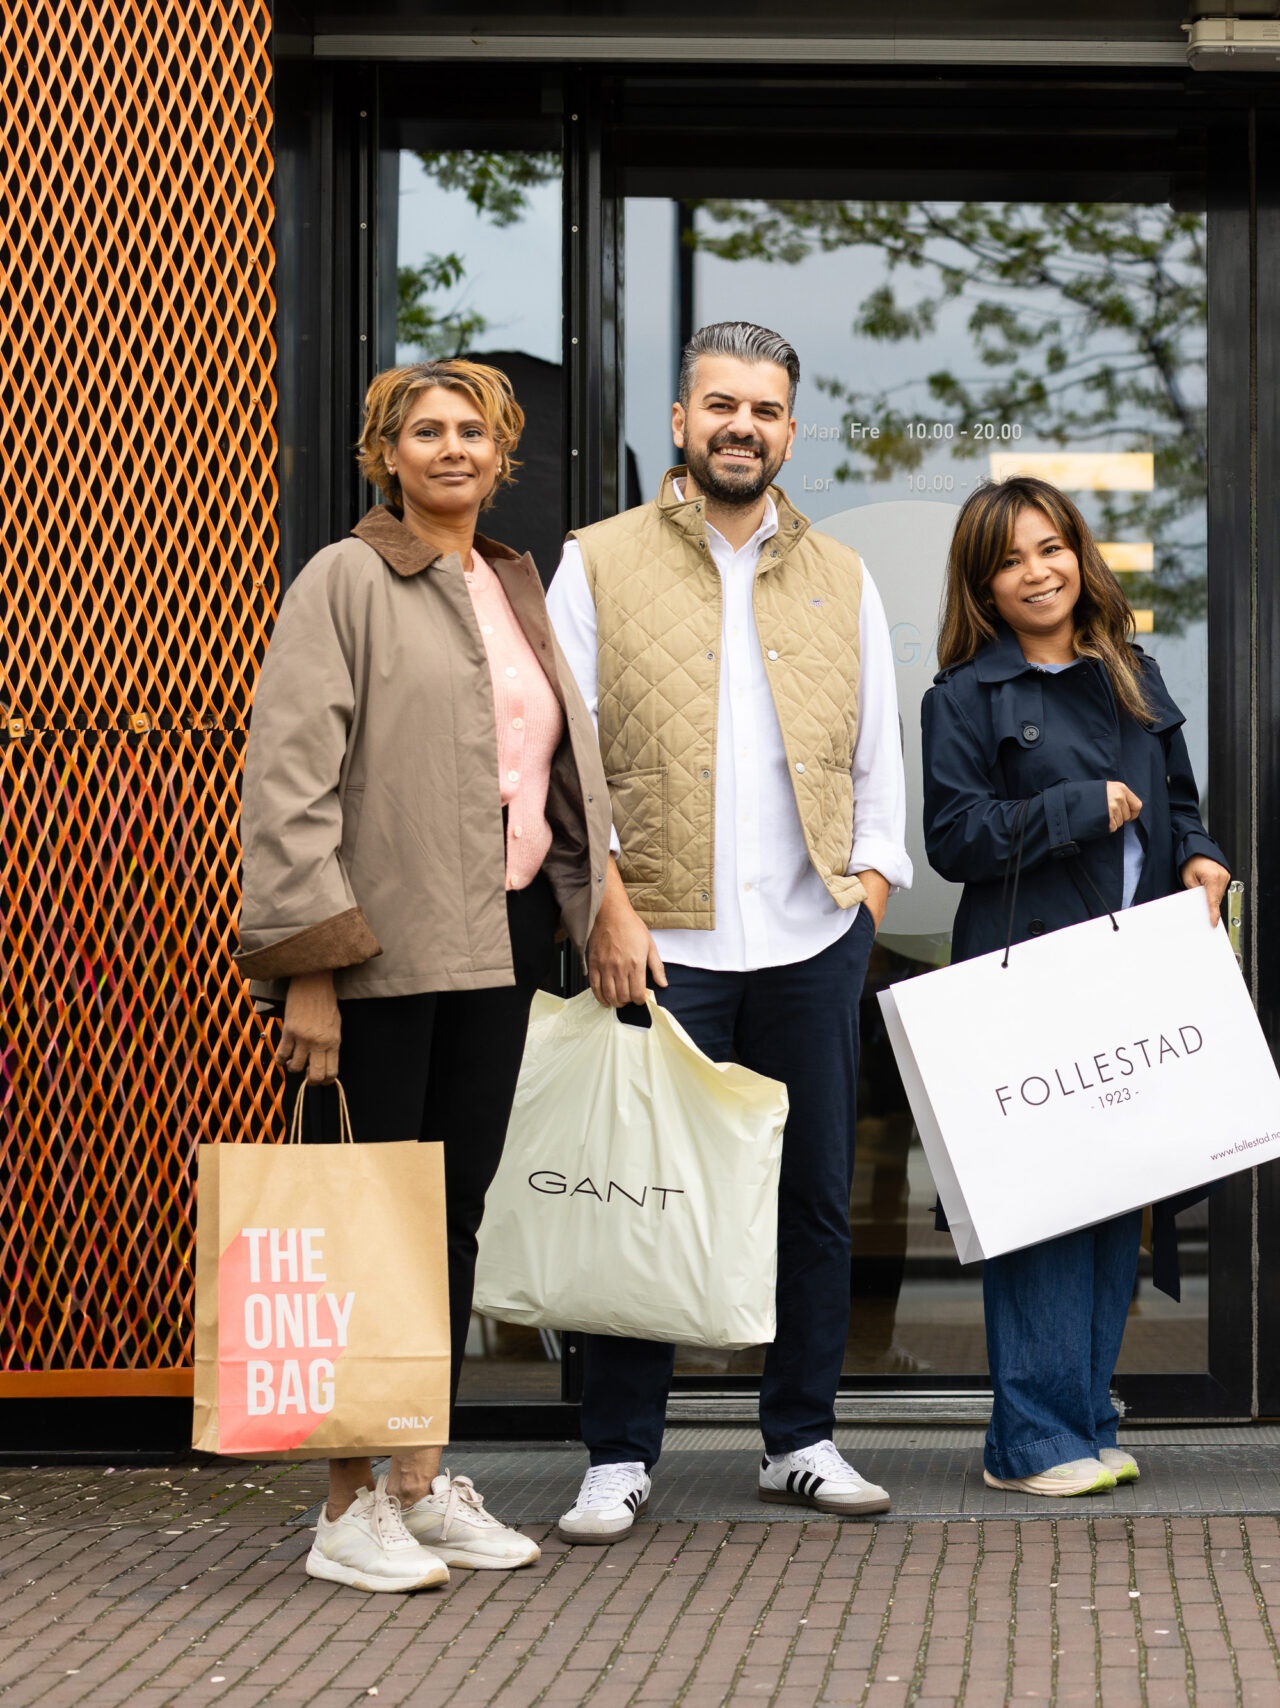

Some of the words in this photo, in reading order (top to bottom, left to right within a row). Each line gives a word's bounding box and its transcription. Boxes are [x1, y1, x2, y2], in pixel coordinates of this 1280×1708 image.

[906, 423, 954, 440] 10.00
[973, 423, 1022, 440] 20.00
[906, 475, 954, 491] 10.00
[994, 1025, 1204, 1116] FOLLESTAD
[1098, 1087, 1131, 1110] 1923
[528, 1170, 685, 1211] GANT
[241, 1228, 327, 1282] THE
[244, 1291, 355, 1350] ONLY
[246, 1358, 335, 1416] BAG
[387, 1415, 433, 1430] ONLY
